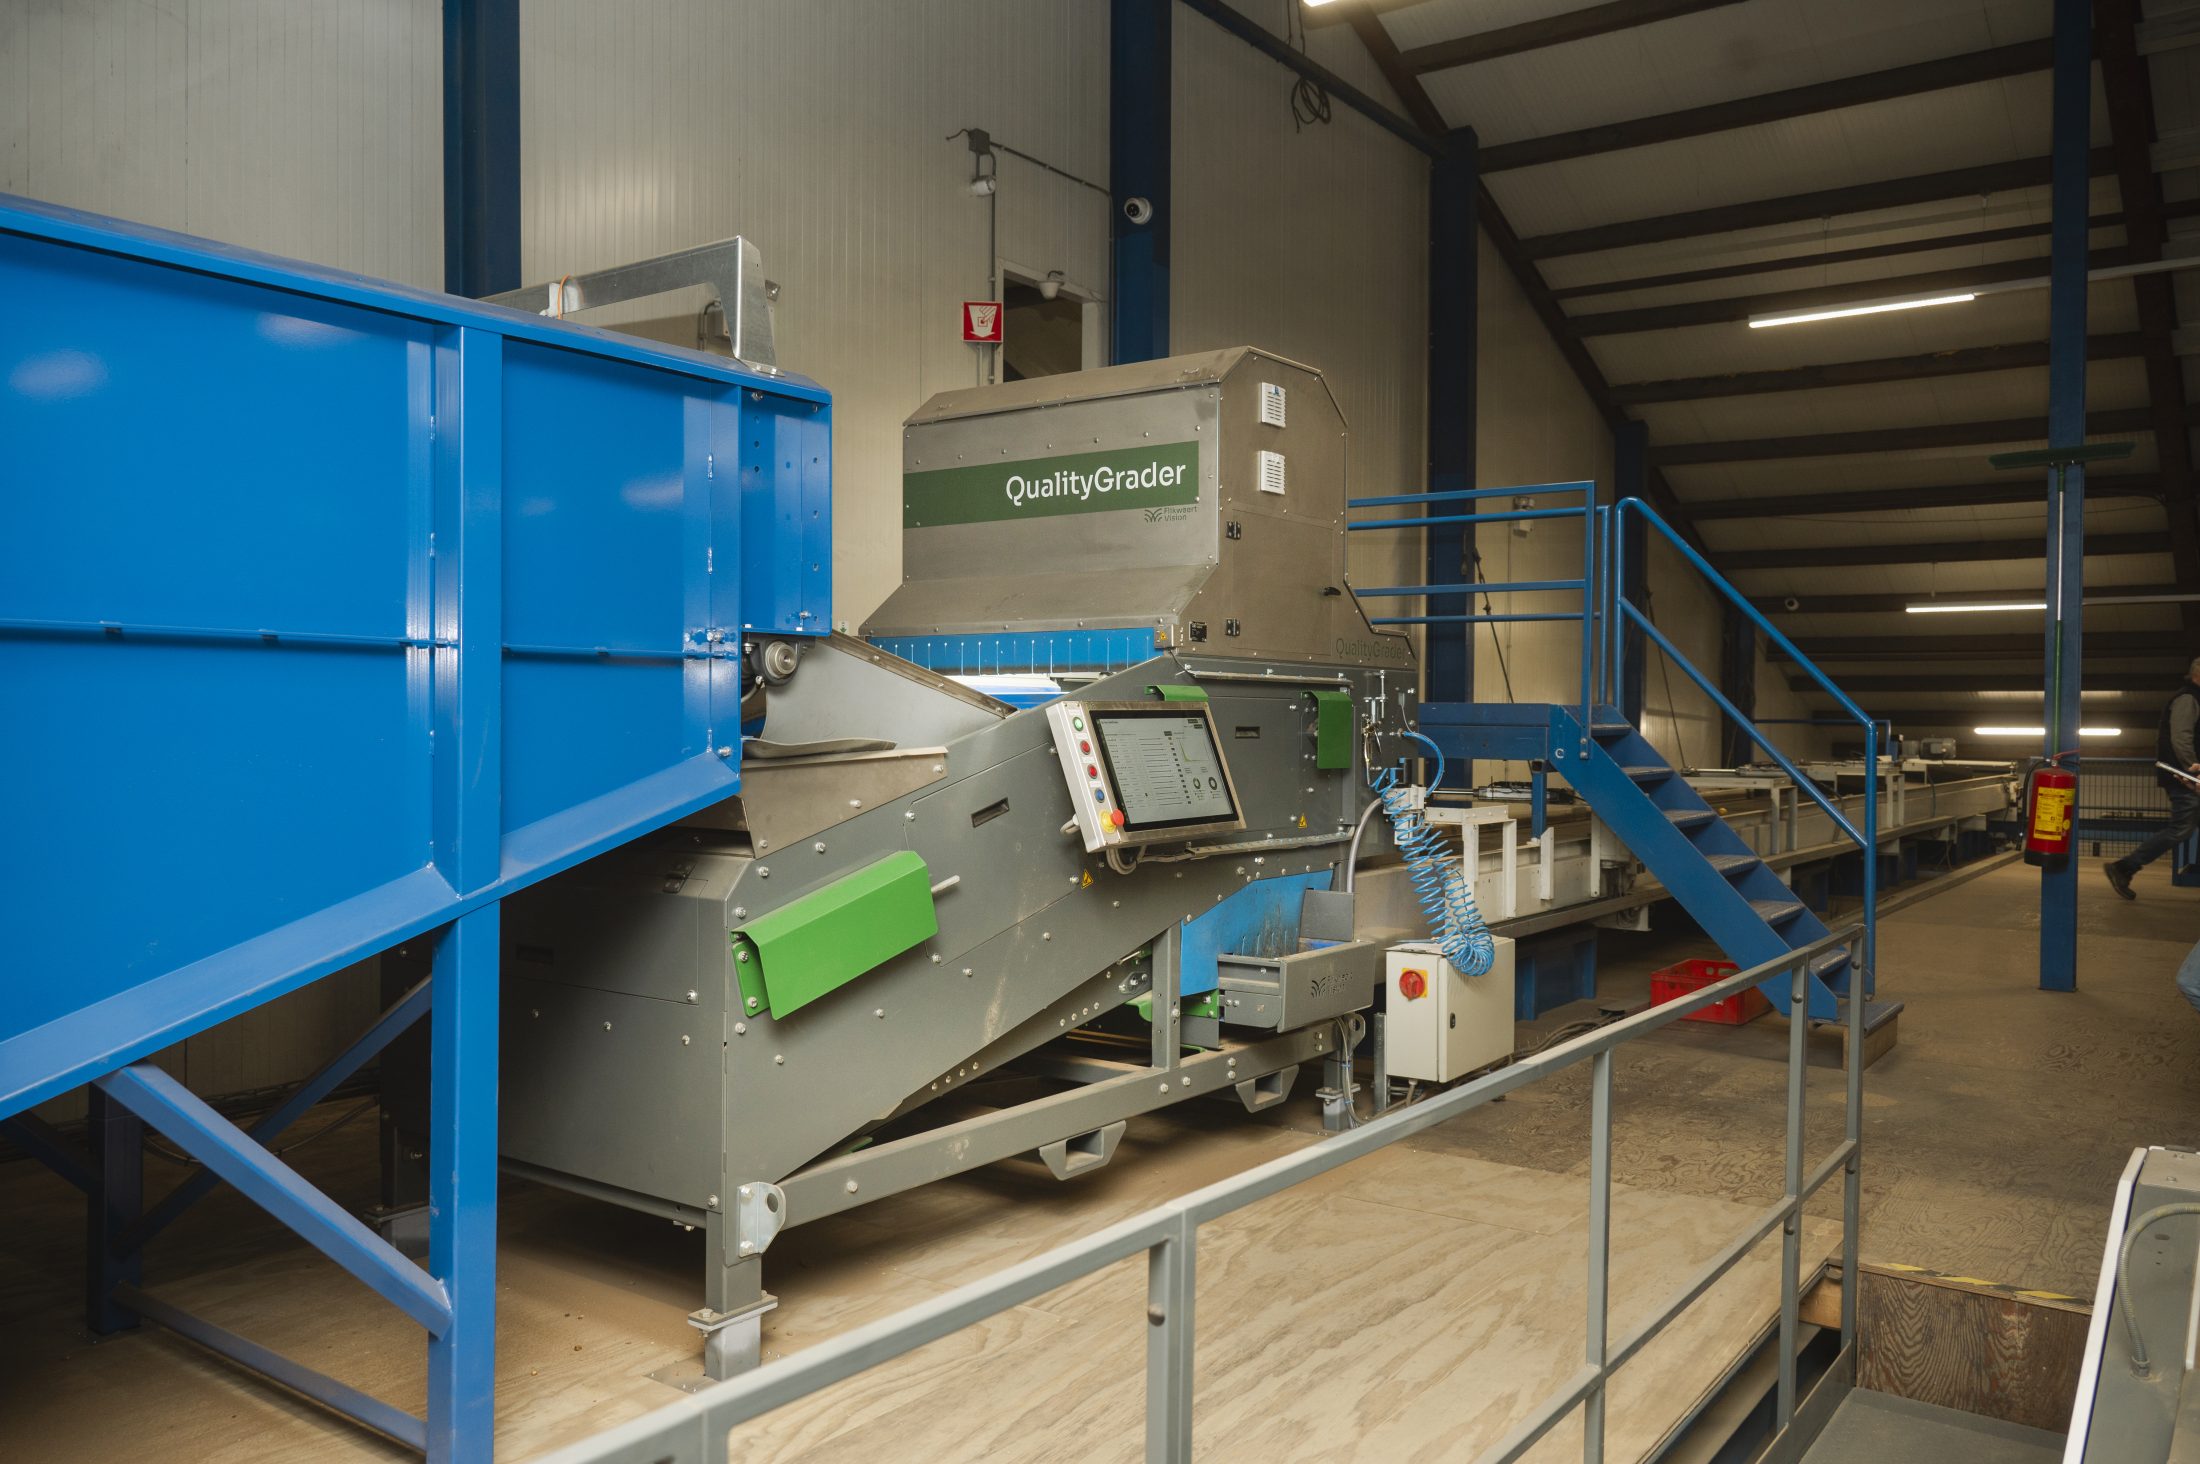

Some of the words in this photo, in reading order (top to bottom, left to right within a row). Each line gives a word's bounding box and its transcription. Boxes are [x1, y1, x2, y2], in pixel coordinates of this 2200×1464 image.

[1006, 462, 1186, 506] QualityGrader
[1164, 514, 1187, 522] Vision
[1336, 638, 1405, 661] QualityGrader
